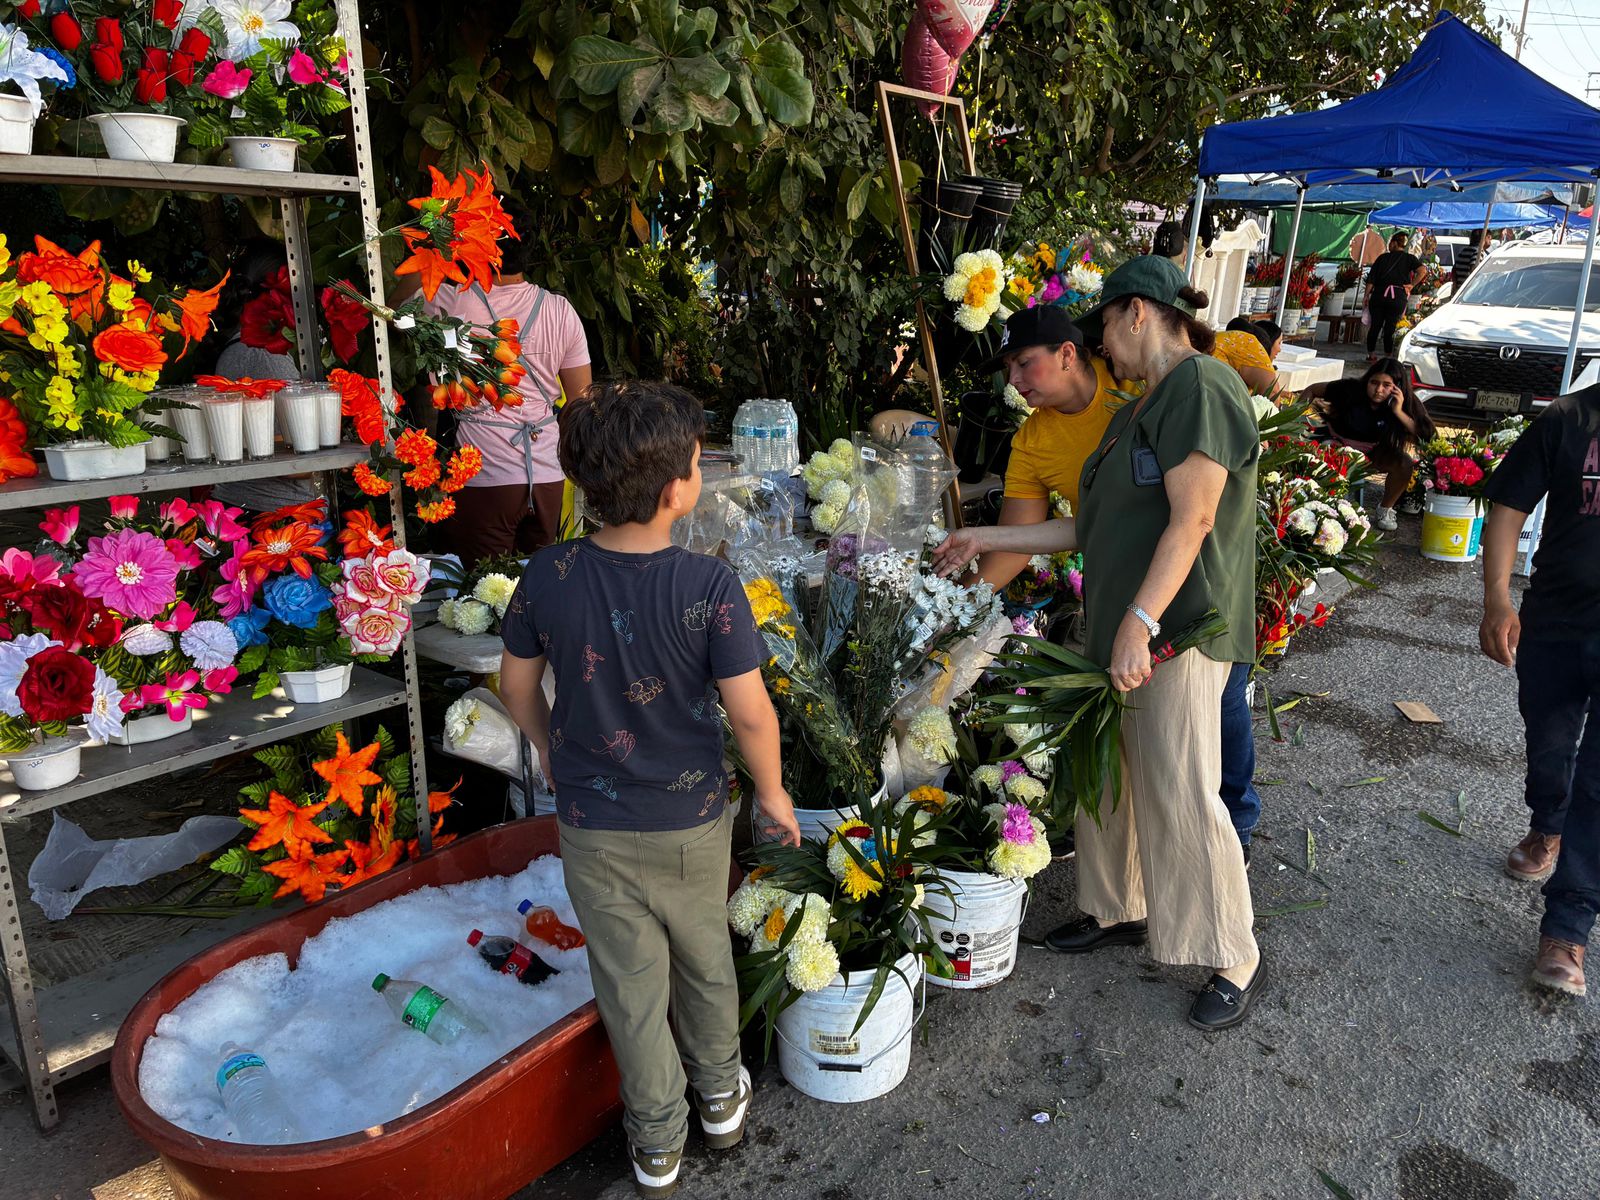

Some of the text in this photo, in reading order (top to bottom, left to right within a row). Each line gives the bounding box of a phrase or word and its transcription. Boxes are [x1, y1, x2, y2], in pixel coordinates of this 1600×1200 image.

[1477, 394, 1519, 408] VPC-724-D
[709, 1102, 725, 1113] NIKE
[651, 1157, 667, 1166] NIKE
